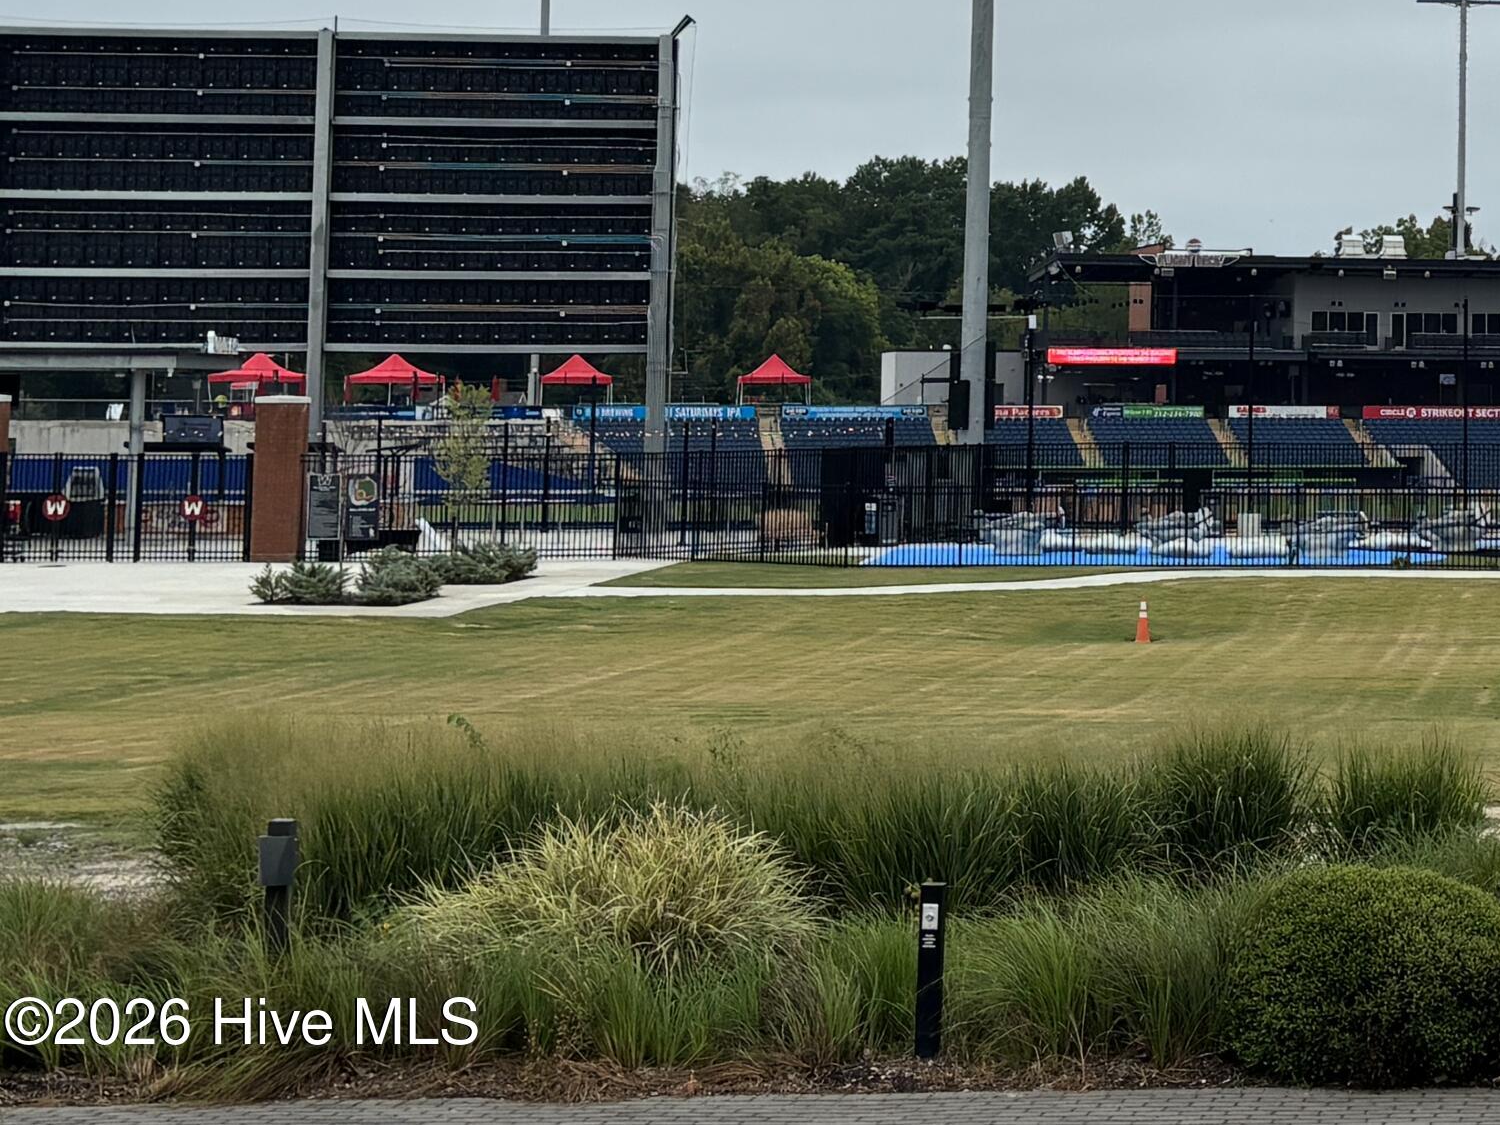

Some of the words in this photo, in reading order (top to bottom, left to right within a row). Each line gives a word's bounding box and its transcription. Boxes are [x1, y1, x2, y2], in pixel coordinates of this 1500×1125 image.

[726, 406, 741, 418] IPA
[46, 499, 66, 515] W
[183, 500, 203, 515] W
